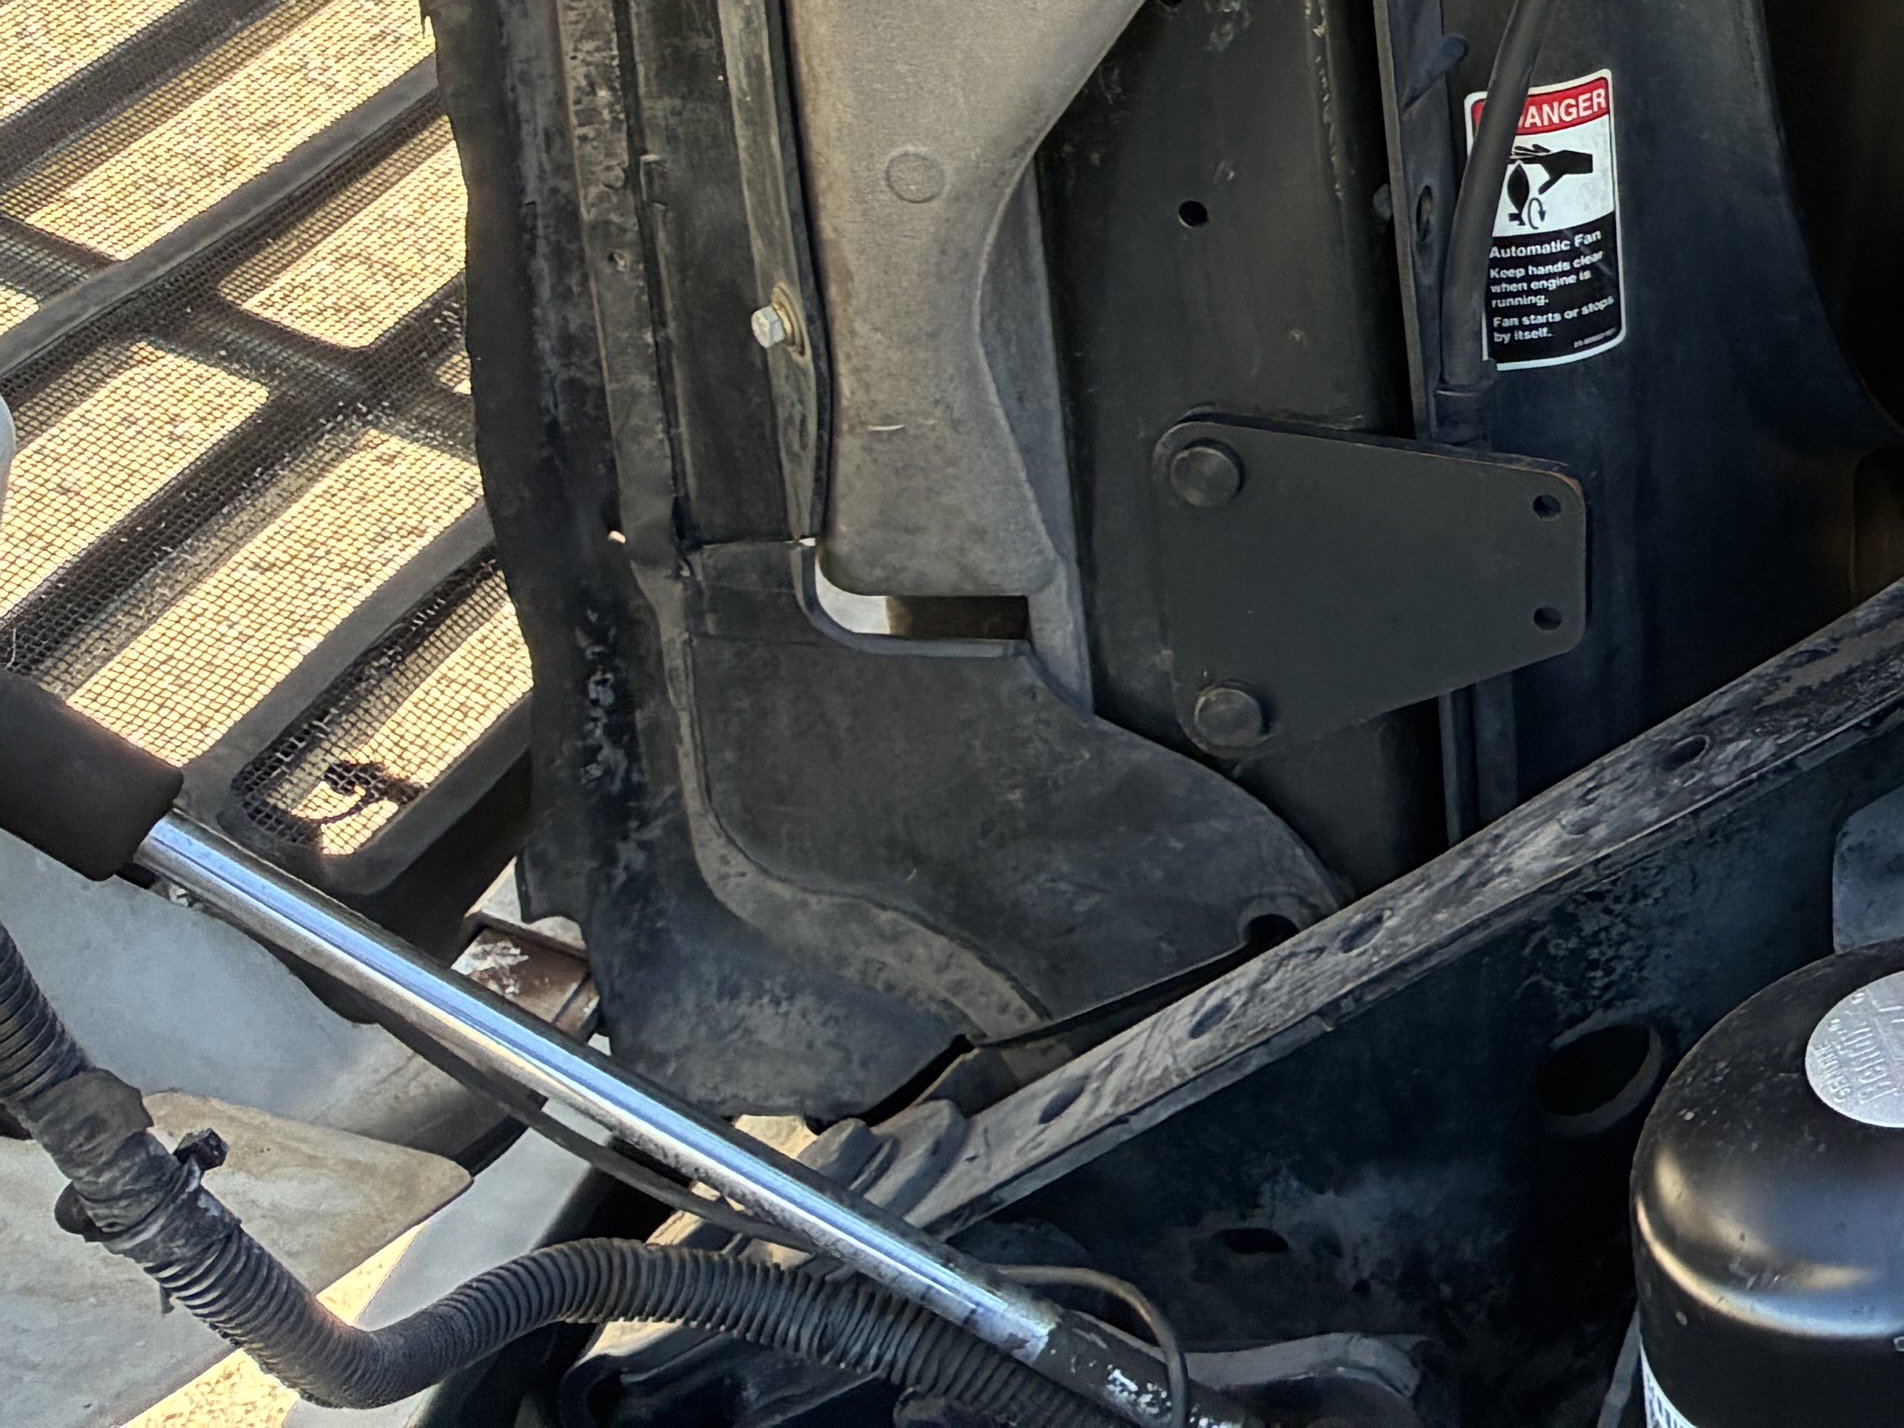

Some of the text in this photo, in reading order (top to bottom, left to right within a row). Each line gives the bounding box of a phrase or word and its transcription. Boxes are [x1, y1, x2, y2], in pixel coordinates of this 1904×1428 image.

[1518, 88, 1606, 129] ANGER
[1489, 229, 1601, 259] Automatic Fan
[1490, 250, 1604, 281] Keep hands clear
[1491, 270, 1591, 293] when engine is
[1491, 294, 1549, 308] running.
[1493, 295, 1614, 328] Fan starts or stops
[1494, 327, 1552, 344] by itself.
